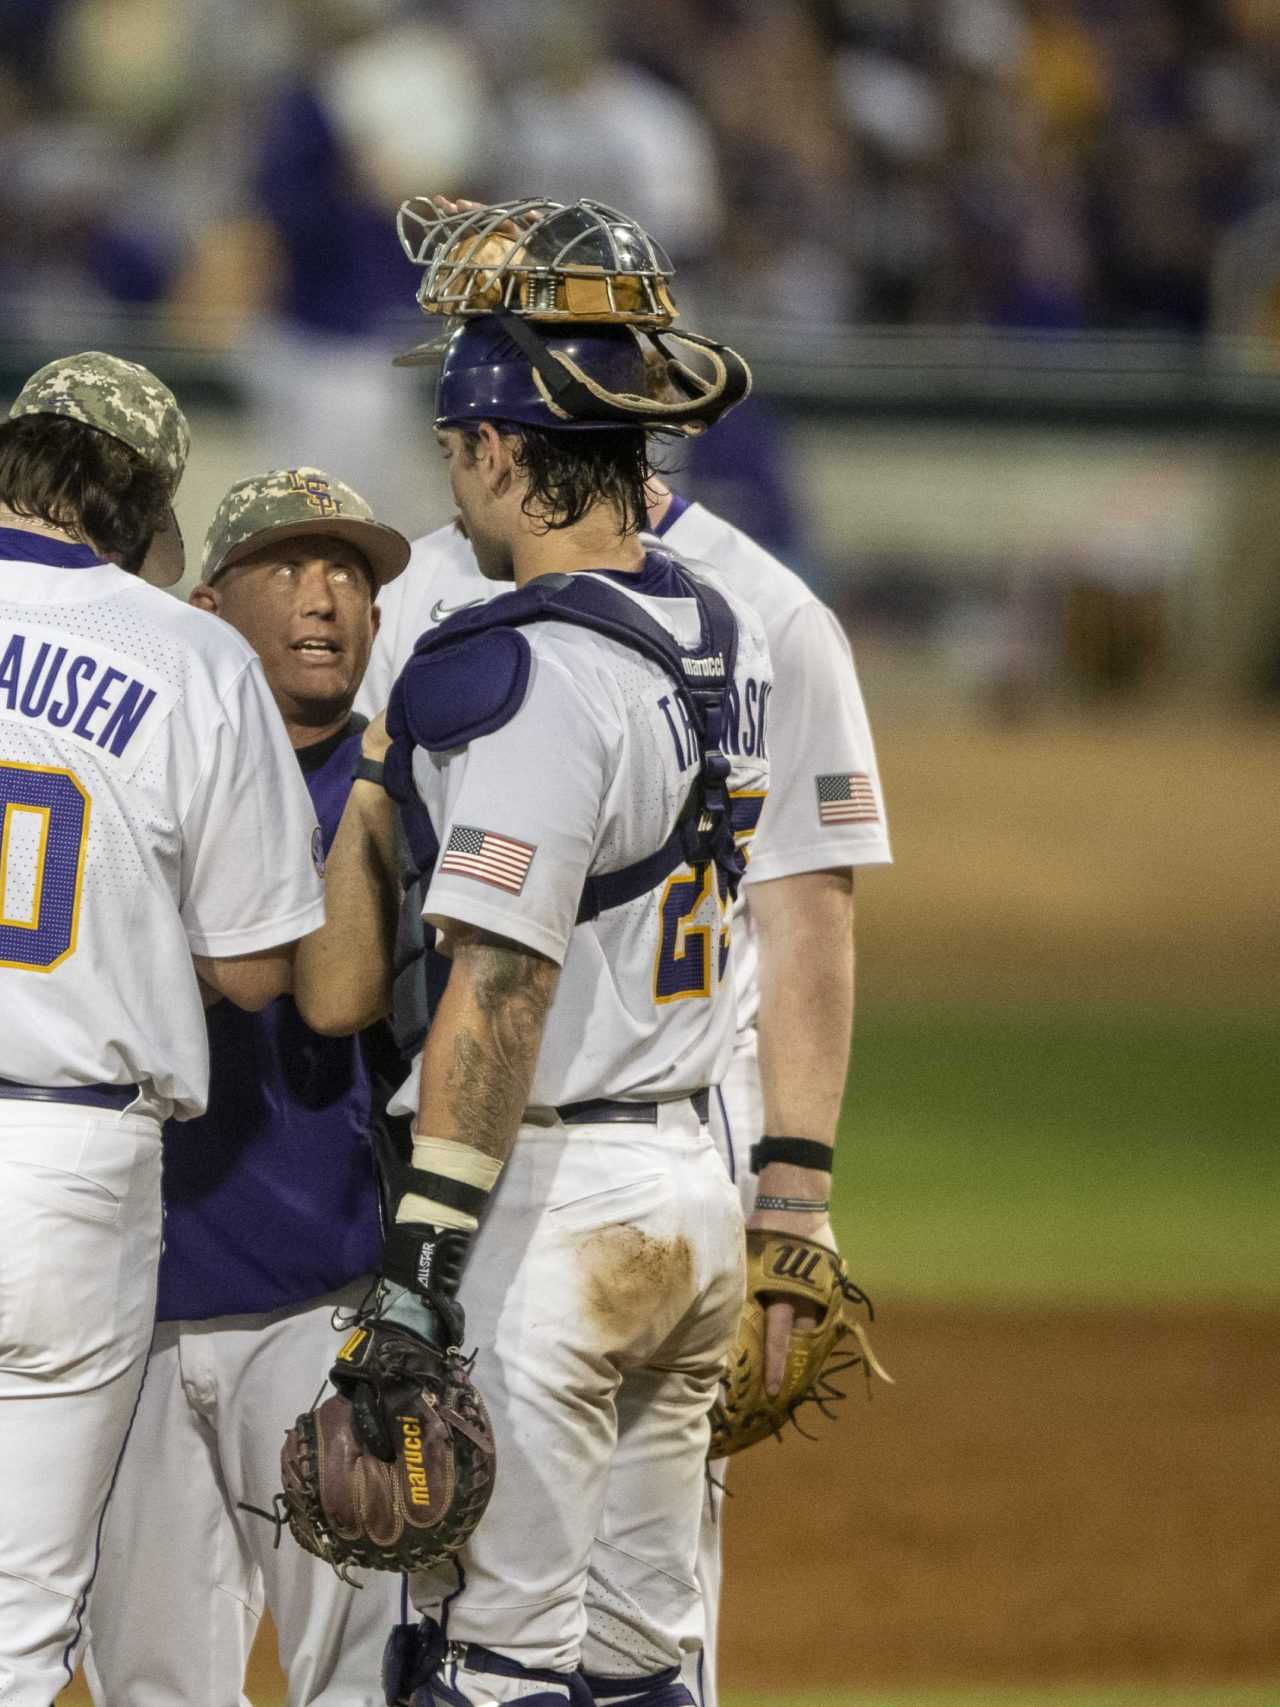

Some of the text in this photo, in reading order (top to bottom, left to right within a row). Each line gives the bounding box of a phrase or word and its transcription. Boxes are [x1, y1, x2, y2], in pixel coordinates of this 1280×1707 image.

[286, 469, 342, 516] LSU
[680, 652, 726, 677] marucci
[395, 1414, 432, 1506] marucci
